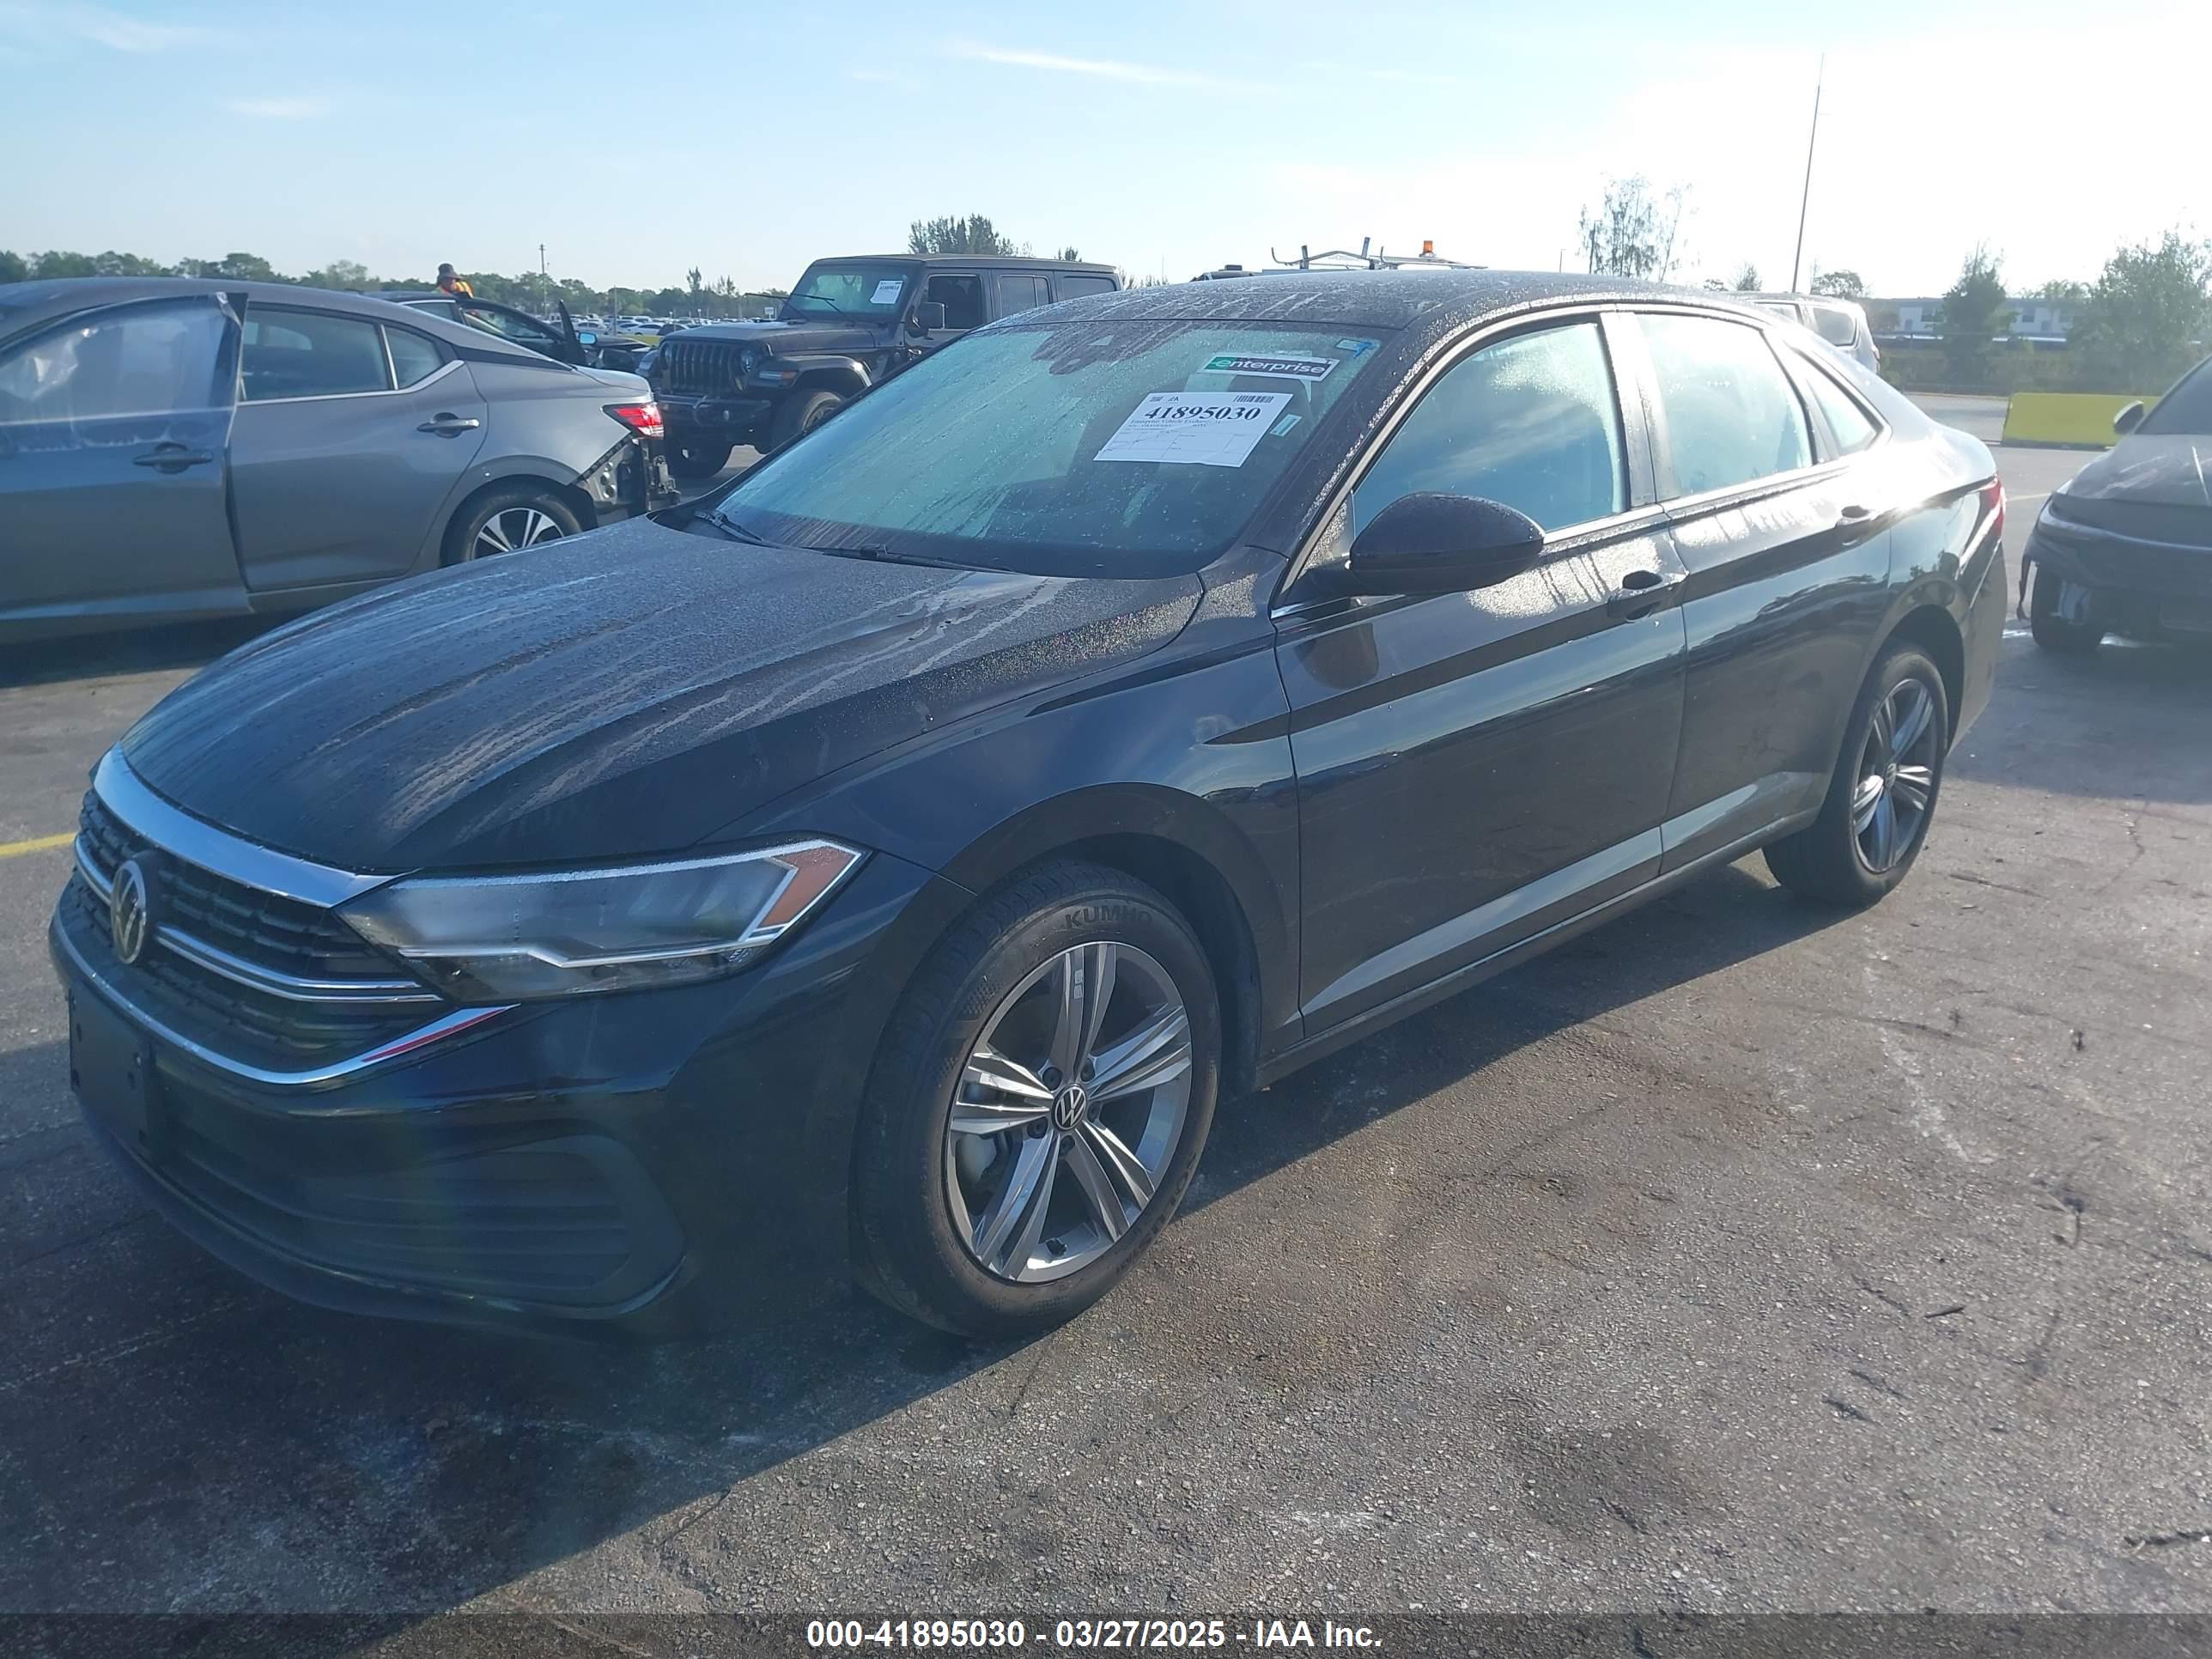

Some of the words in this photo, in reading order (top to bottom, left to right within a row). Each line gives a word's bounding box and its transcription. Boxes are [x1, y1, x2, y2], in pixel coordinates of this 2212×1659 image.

[1215, 359, 1326, 374] enterprise
[1145, 406, 1261, 421] 41895030
[1065, 905, 1153, 929] KUMHO
[1056, 1087, 1086, 1129] VW
